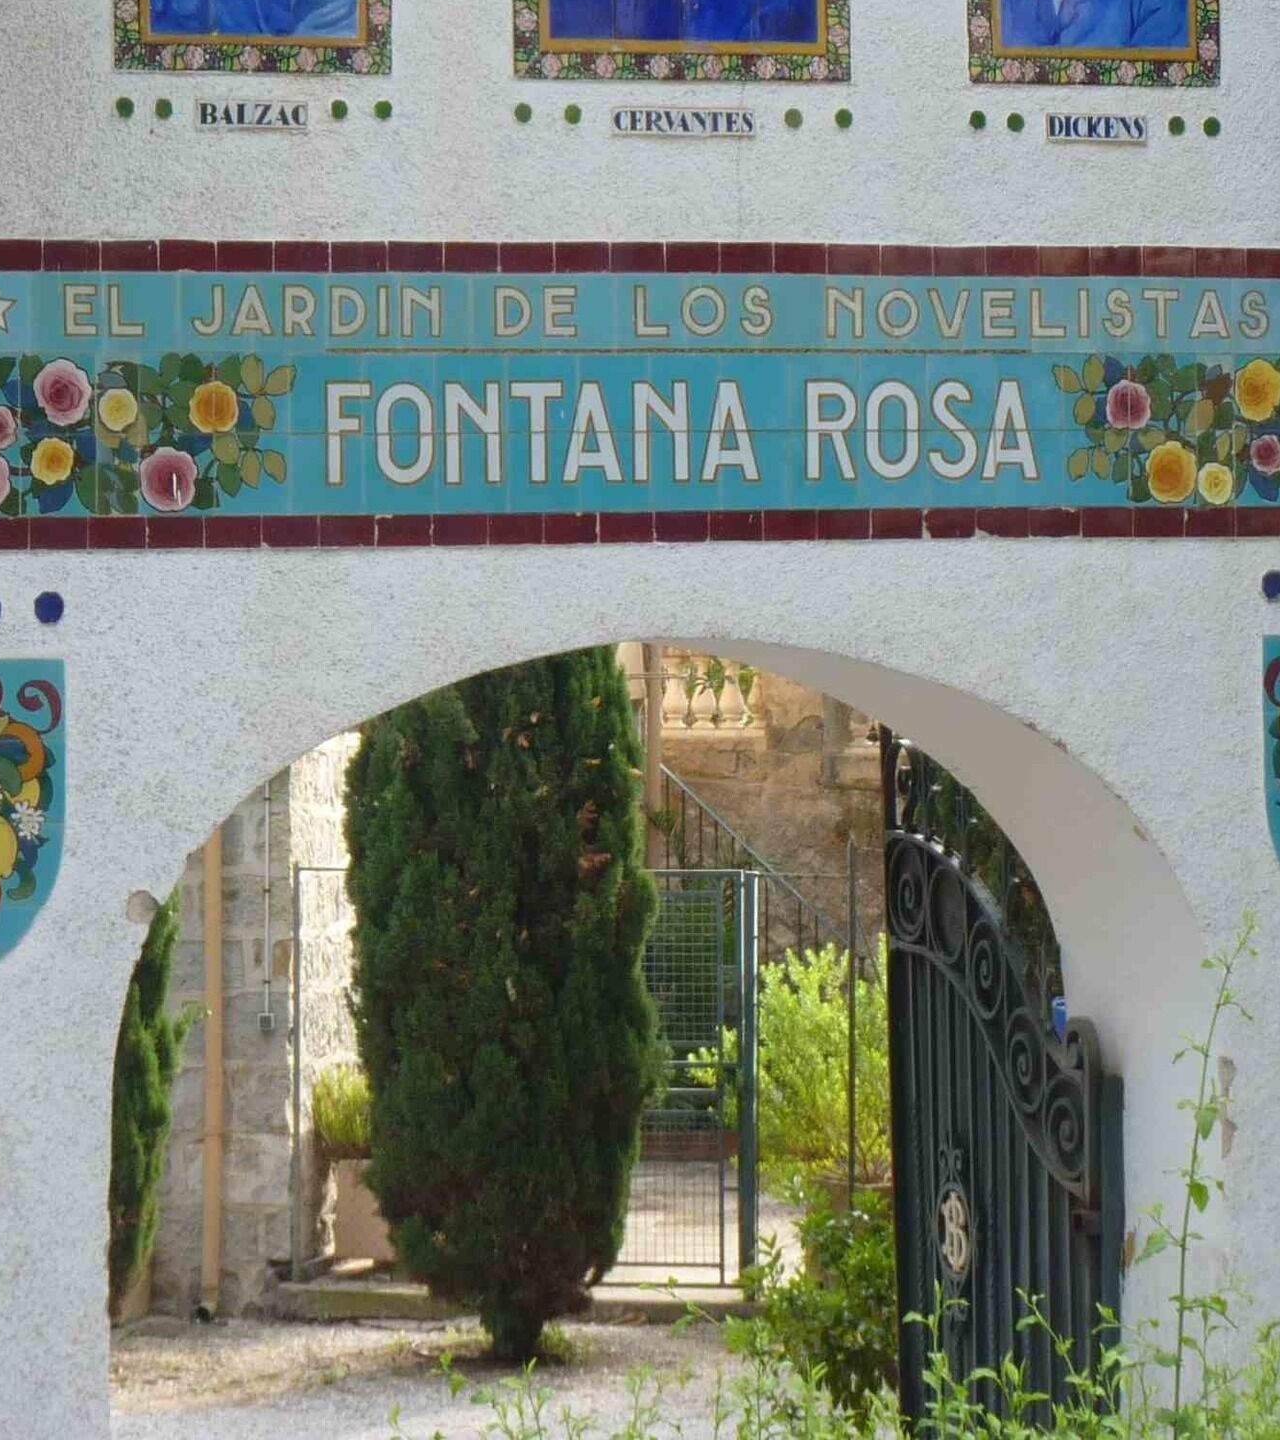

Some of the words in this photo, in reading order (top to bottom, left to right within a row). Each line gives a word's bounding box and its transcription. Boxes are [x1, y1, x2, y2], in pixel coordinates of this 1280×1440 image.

[199, 102, 308, 127] BALZAC
[613, 109, 754, 134] CERVANTES
[1048, 115, 1145, 140] DICKENS
[62, 282, 146, 338] EL
[191, 283, 442, 338] JARDIN
[493, 284, 579, 338] DE
[632, 284, 774, 338] LOS
[824, 287, 1271, 340] NOVELISTAS
[324, 379, 760, 485] FONTANA
[802, 378, 1041, 483] ROSA
